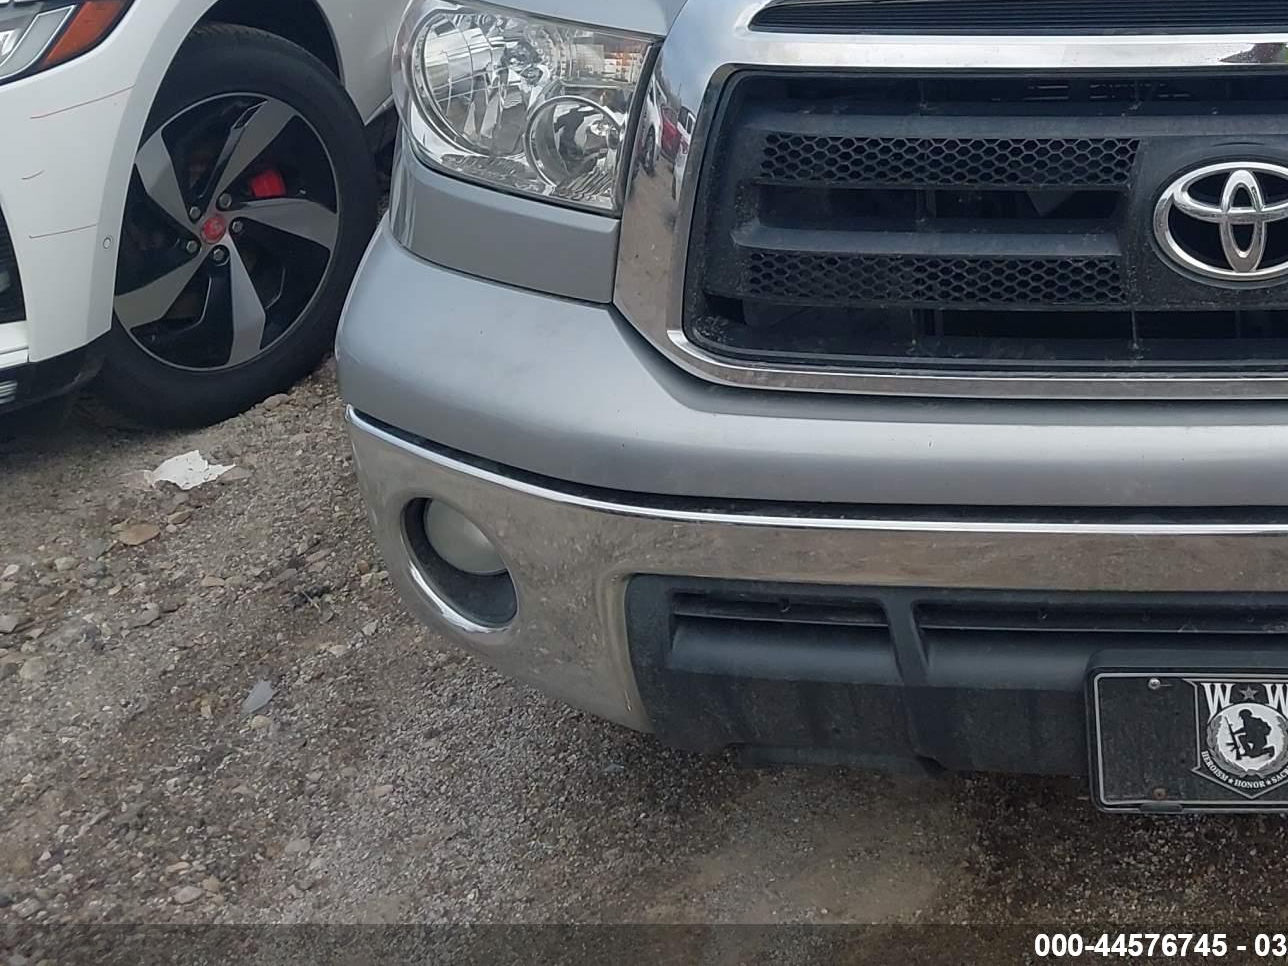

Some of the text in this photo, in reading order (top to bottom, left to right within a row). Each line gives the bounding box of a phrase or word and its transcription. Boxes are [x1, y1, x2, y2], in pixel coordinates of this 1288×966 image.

[1200, 682, 1236, 724] W
[1201, 750, 1230, 783] HEROISM
[1234, 778, 1266, 789] HONOR
